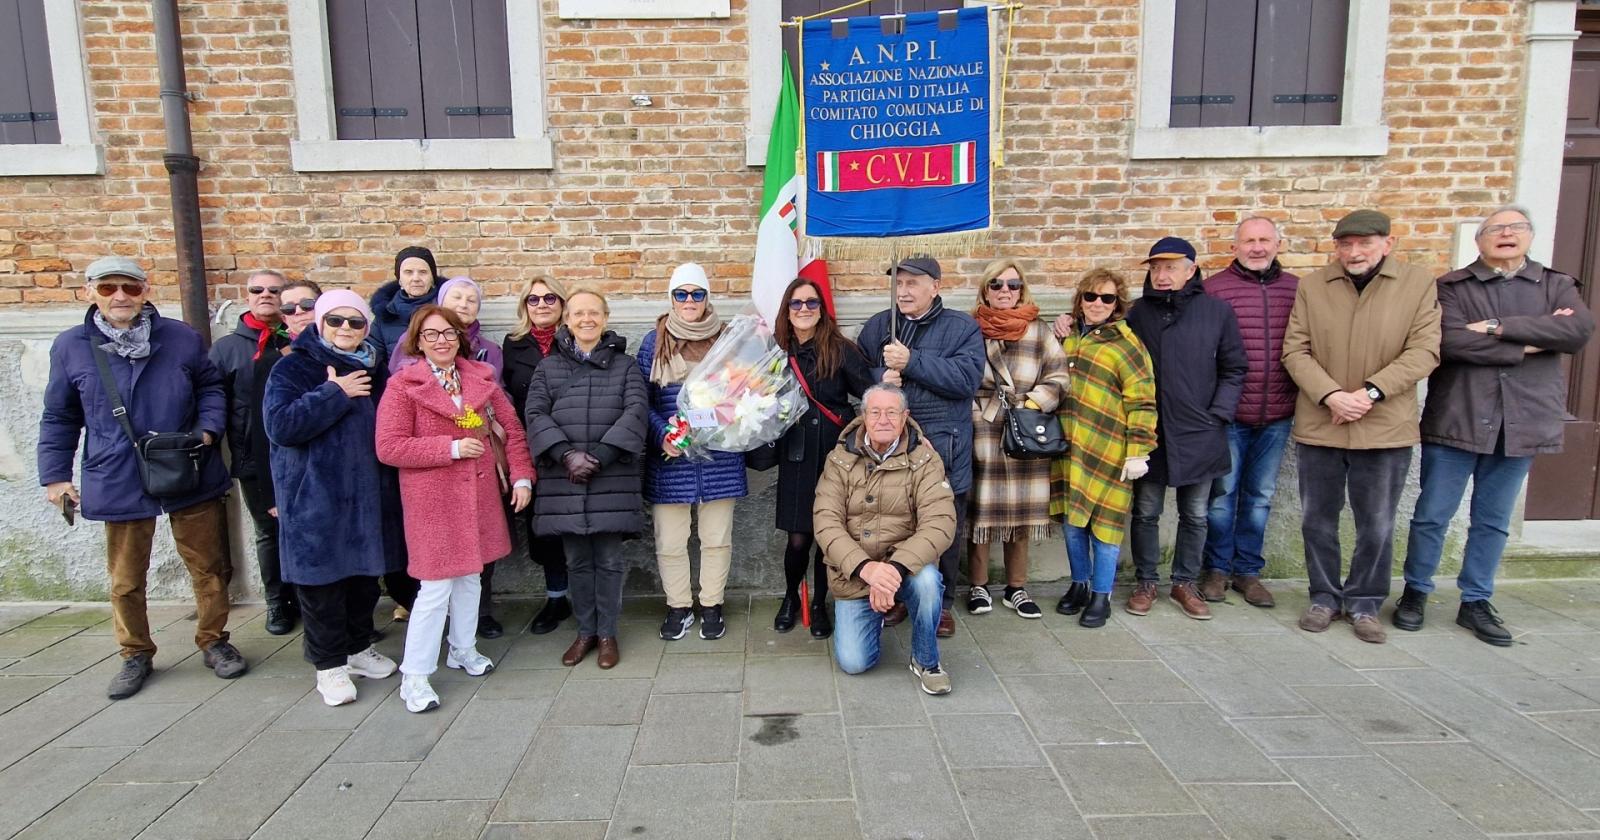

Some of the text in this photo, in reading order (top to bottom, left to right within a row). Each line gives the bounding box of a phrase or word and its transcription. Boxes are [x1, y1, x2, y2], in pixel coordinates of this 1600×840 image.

[810, 62, 983, 86] ASSOCIAZIONE NAZIONALE
[823, 87, 902, 103] PARTIGIANI
[810, 98, 984, 120] COMITATO COMUNALE DI
[850, 121, 941, 140] CHIOGGIA
